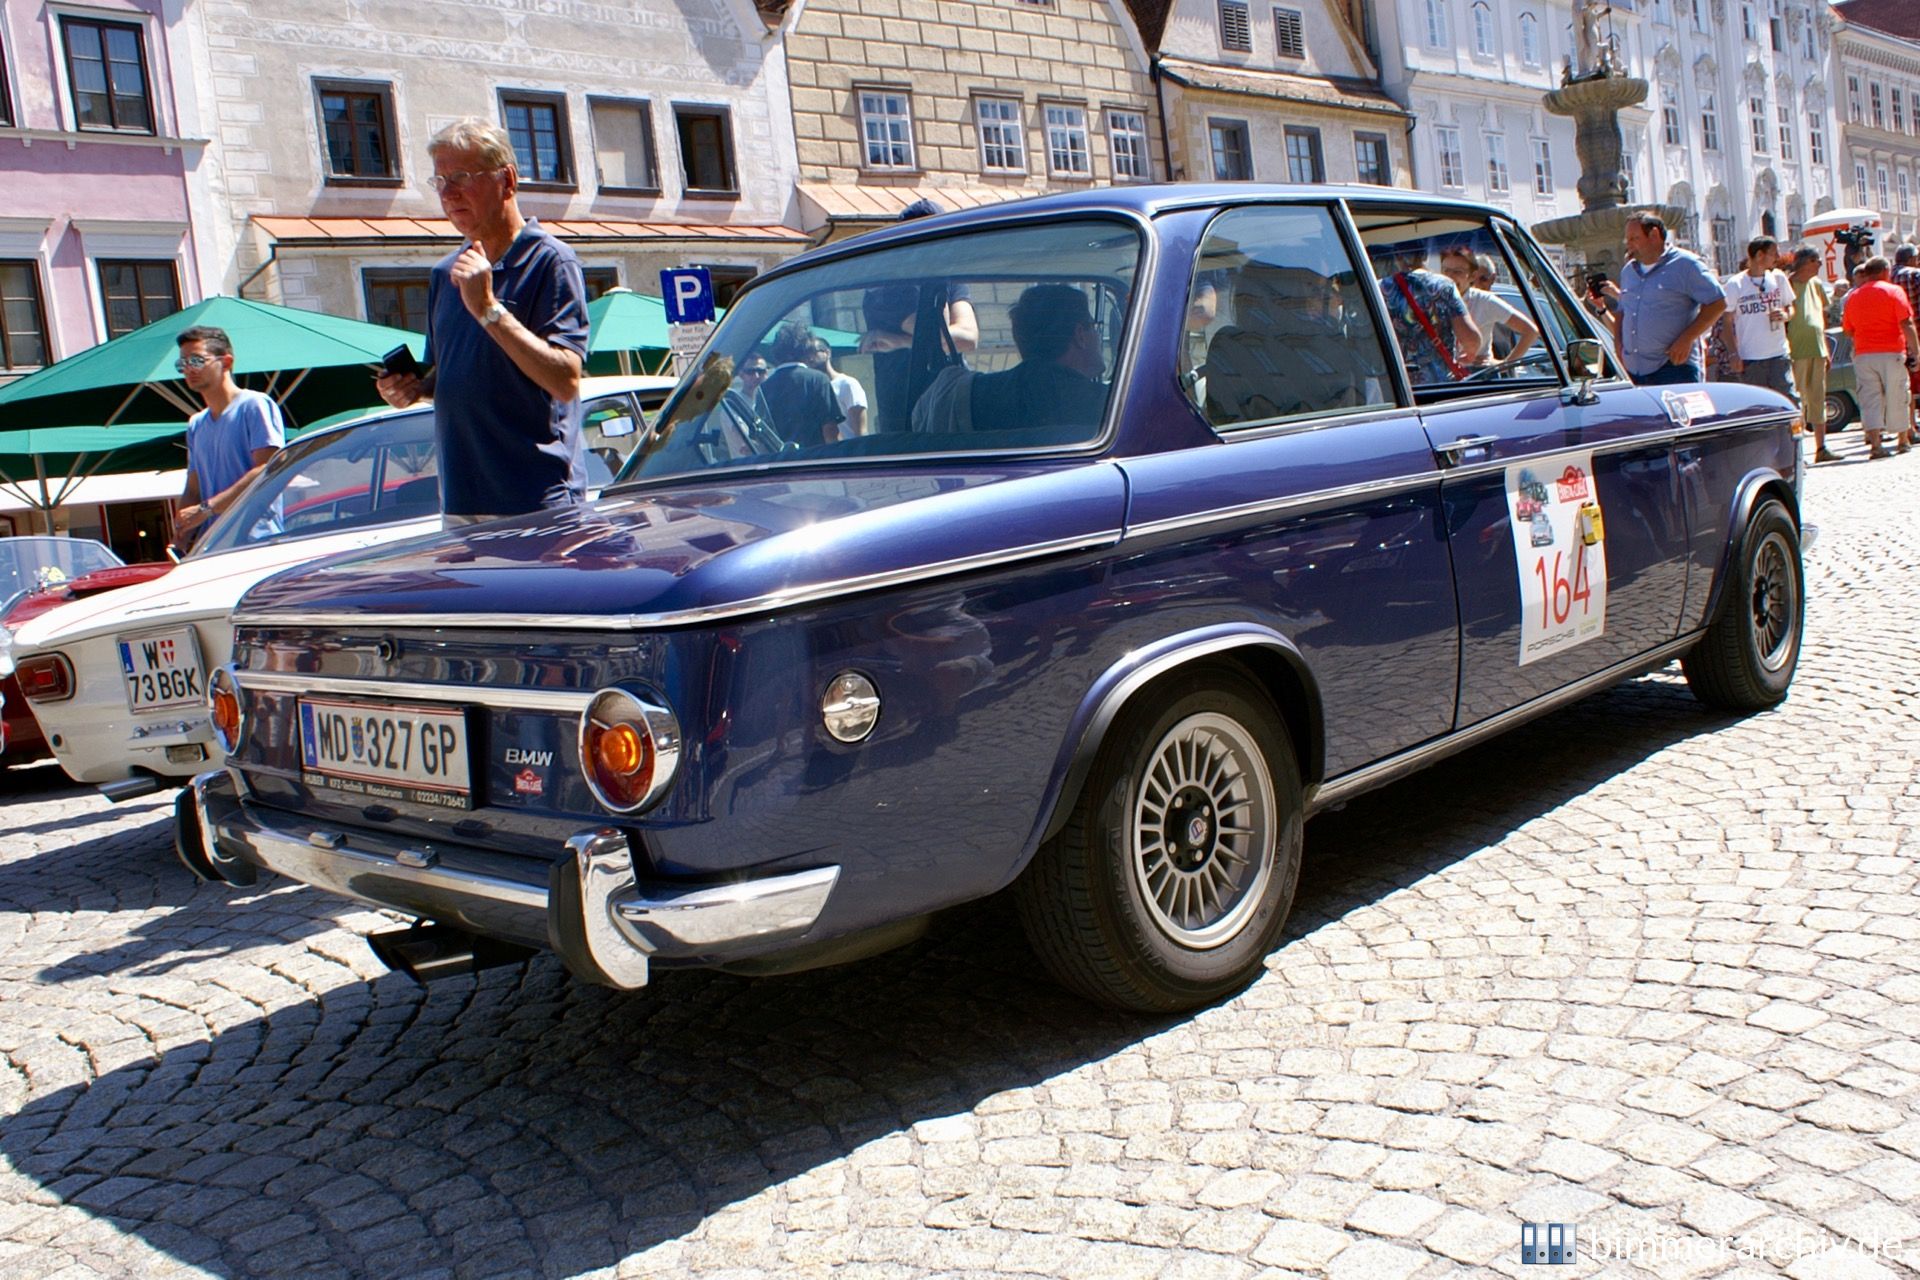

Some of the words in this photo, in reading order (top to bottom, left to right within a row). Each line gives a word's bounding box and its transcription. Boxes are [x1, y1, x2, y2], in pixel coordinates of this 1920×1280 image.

[674, 275, 702, 316] P
[1535, 544, 1590, 630] 164
[142, 641, 160, 670] W
[1526, 628, 1576, 653] PORSCHE
[128, 674, 156, 703] 73
[157, 667, 200, 700] BGK
[318, 712, 349, 762] MD
[366, 717, 412, 772] 327
[420, 722, 456, 777] GP
[505, 748, 553, 767] BMW
